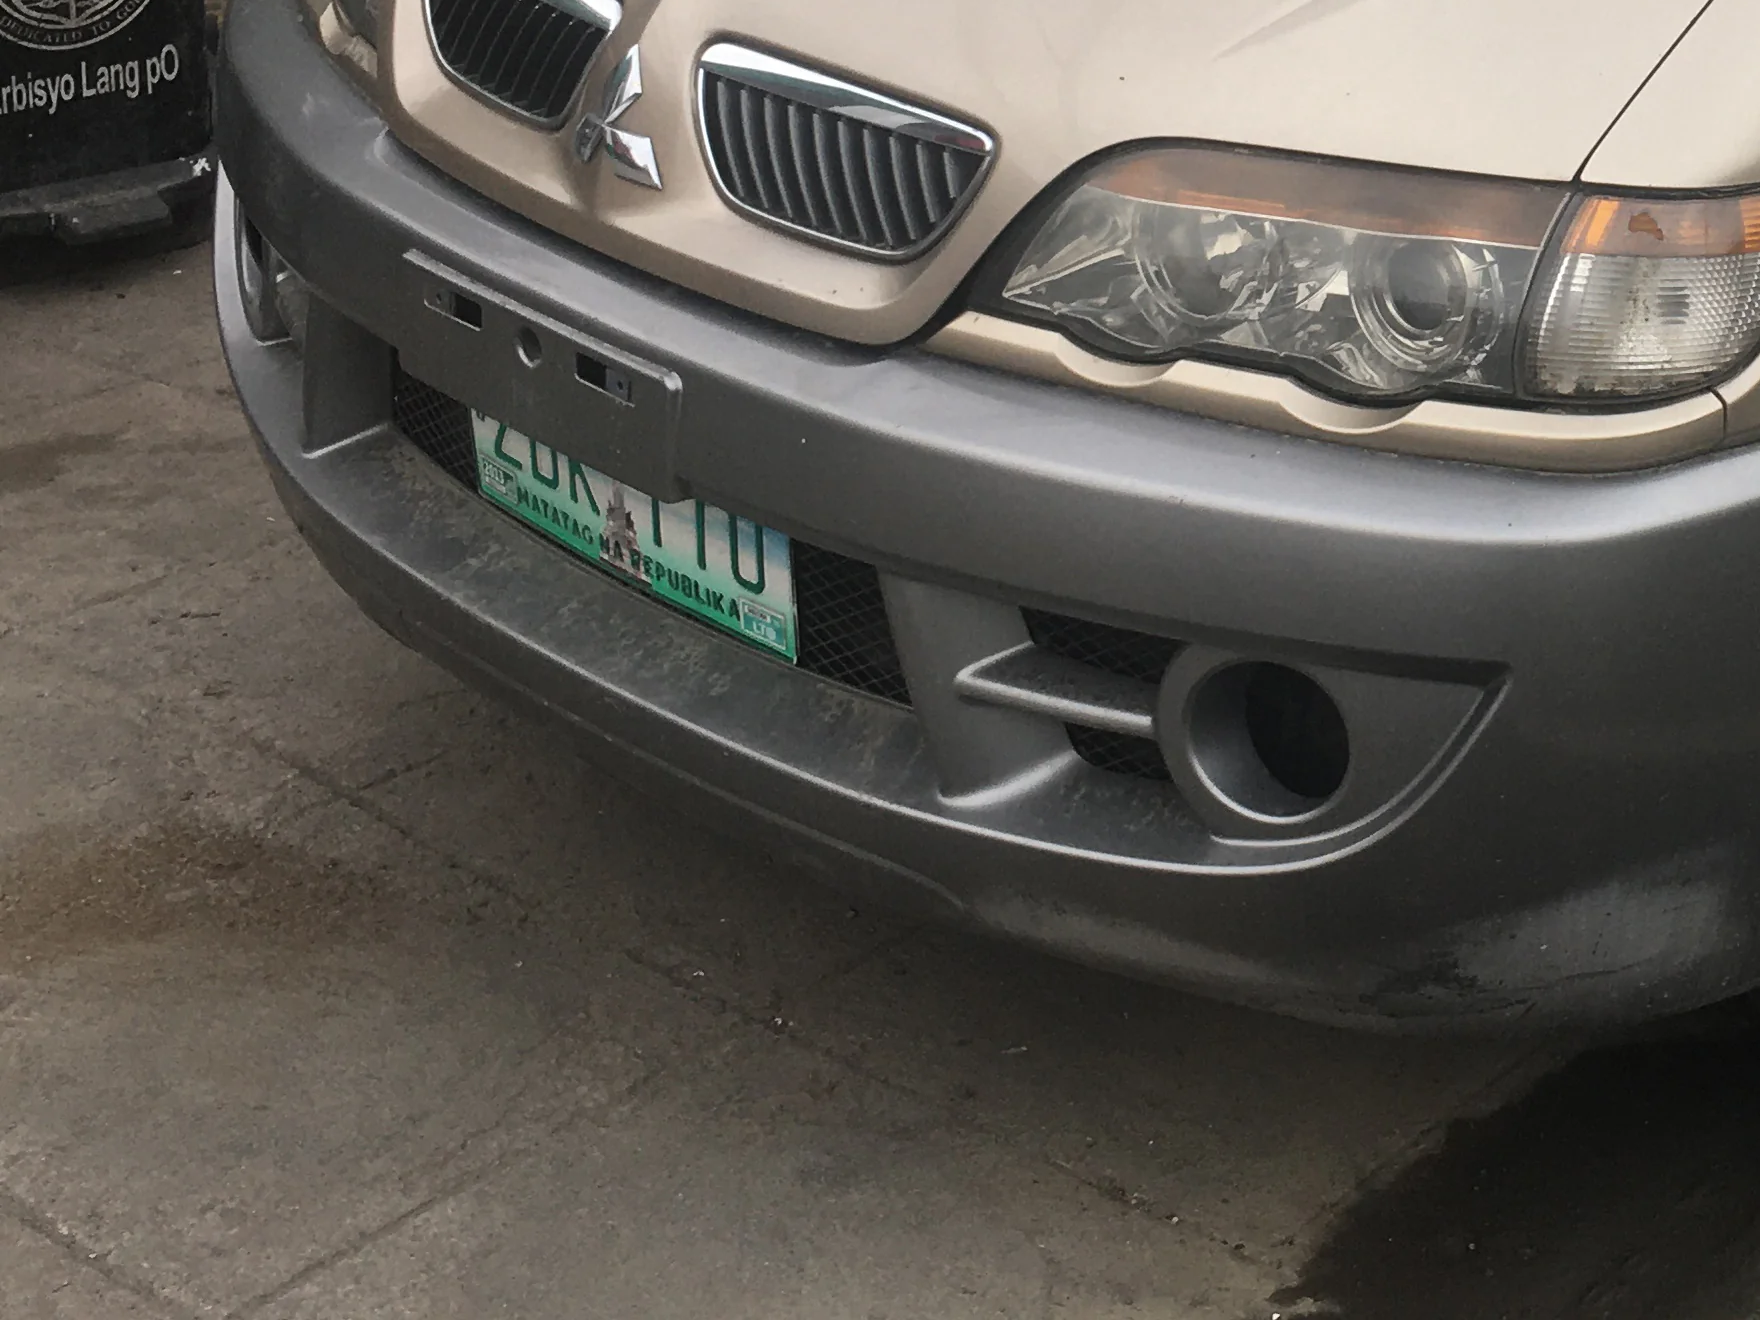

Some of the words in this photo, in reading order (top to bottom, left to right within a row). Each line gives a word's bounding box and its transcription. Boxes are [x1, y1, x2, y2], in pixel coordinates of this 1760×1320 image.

[0, 72, 75, 115] rbisyo
[81, 61, 140, 99] Lang
[517, 486, 594, 545] MATATAG
[628, 547, 741, 622] REPUBLIKA
